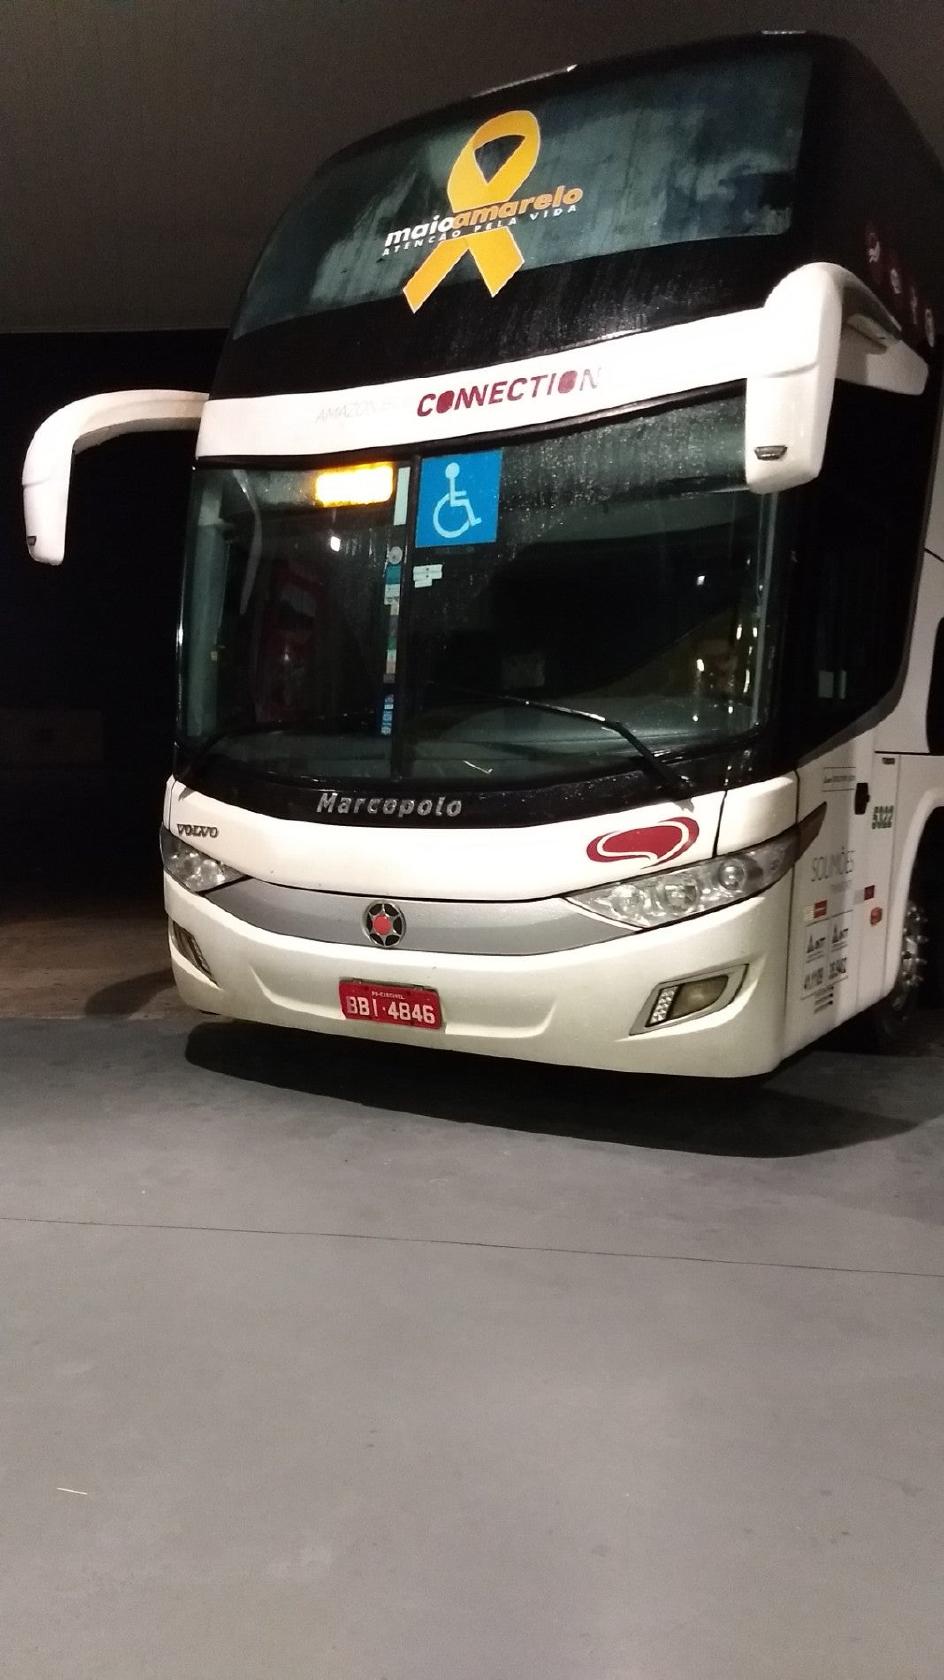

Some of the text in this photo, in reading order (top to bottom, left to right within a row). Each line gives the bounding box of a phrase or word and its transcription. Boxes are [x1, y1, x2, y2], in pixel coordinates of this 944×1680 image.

[474, 217, 517, 233] PELA
[530, 204, 577, 221] VIDA
[416, 368, 602, 418] CONNECTION
[316, 792, 462, 818] Marcopolo
[177, 823, 219, 839] VOLVO
